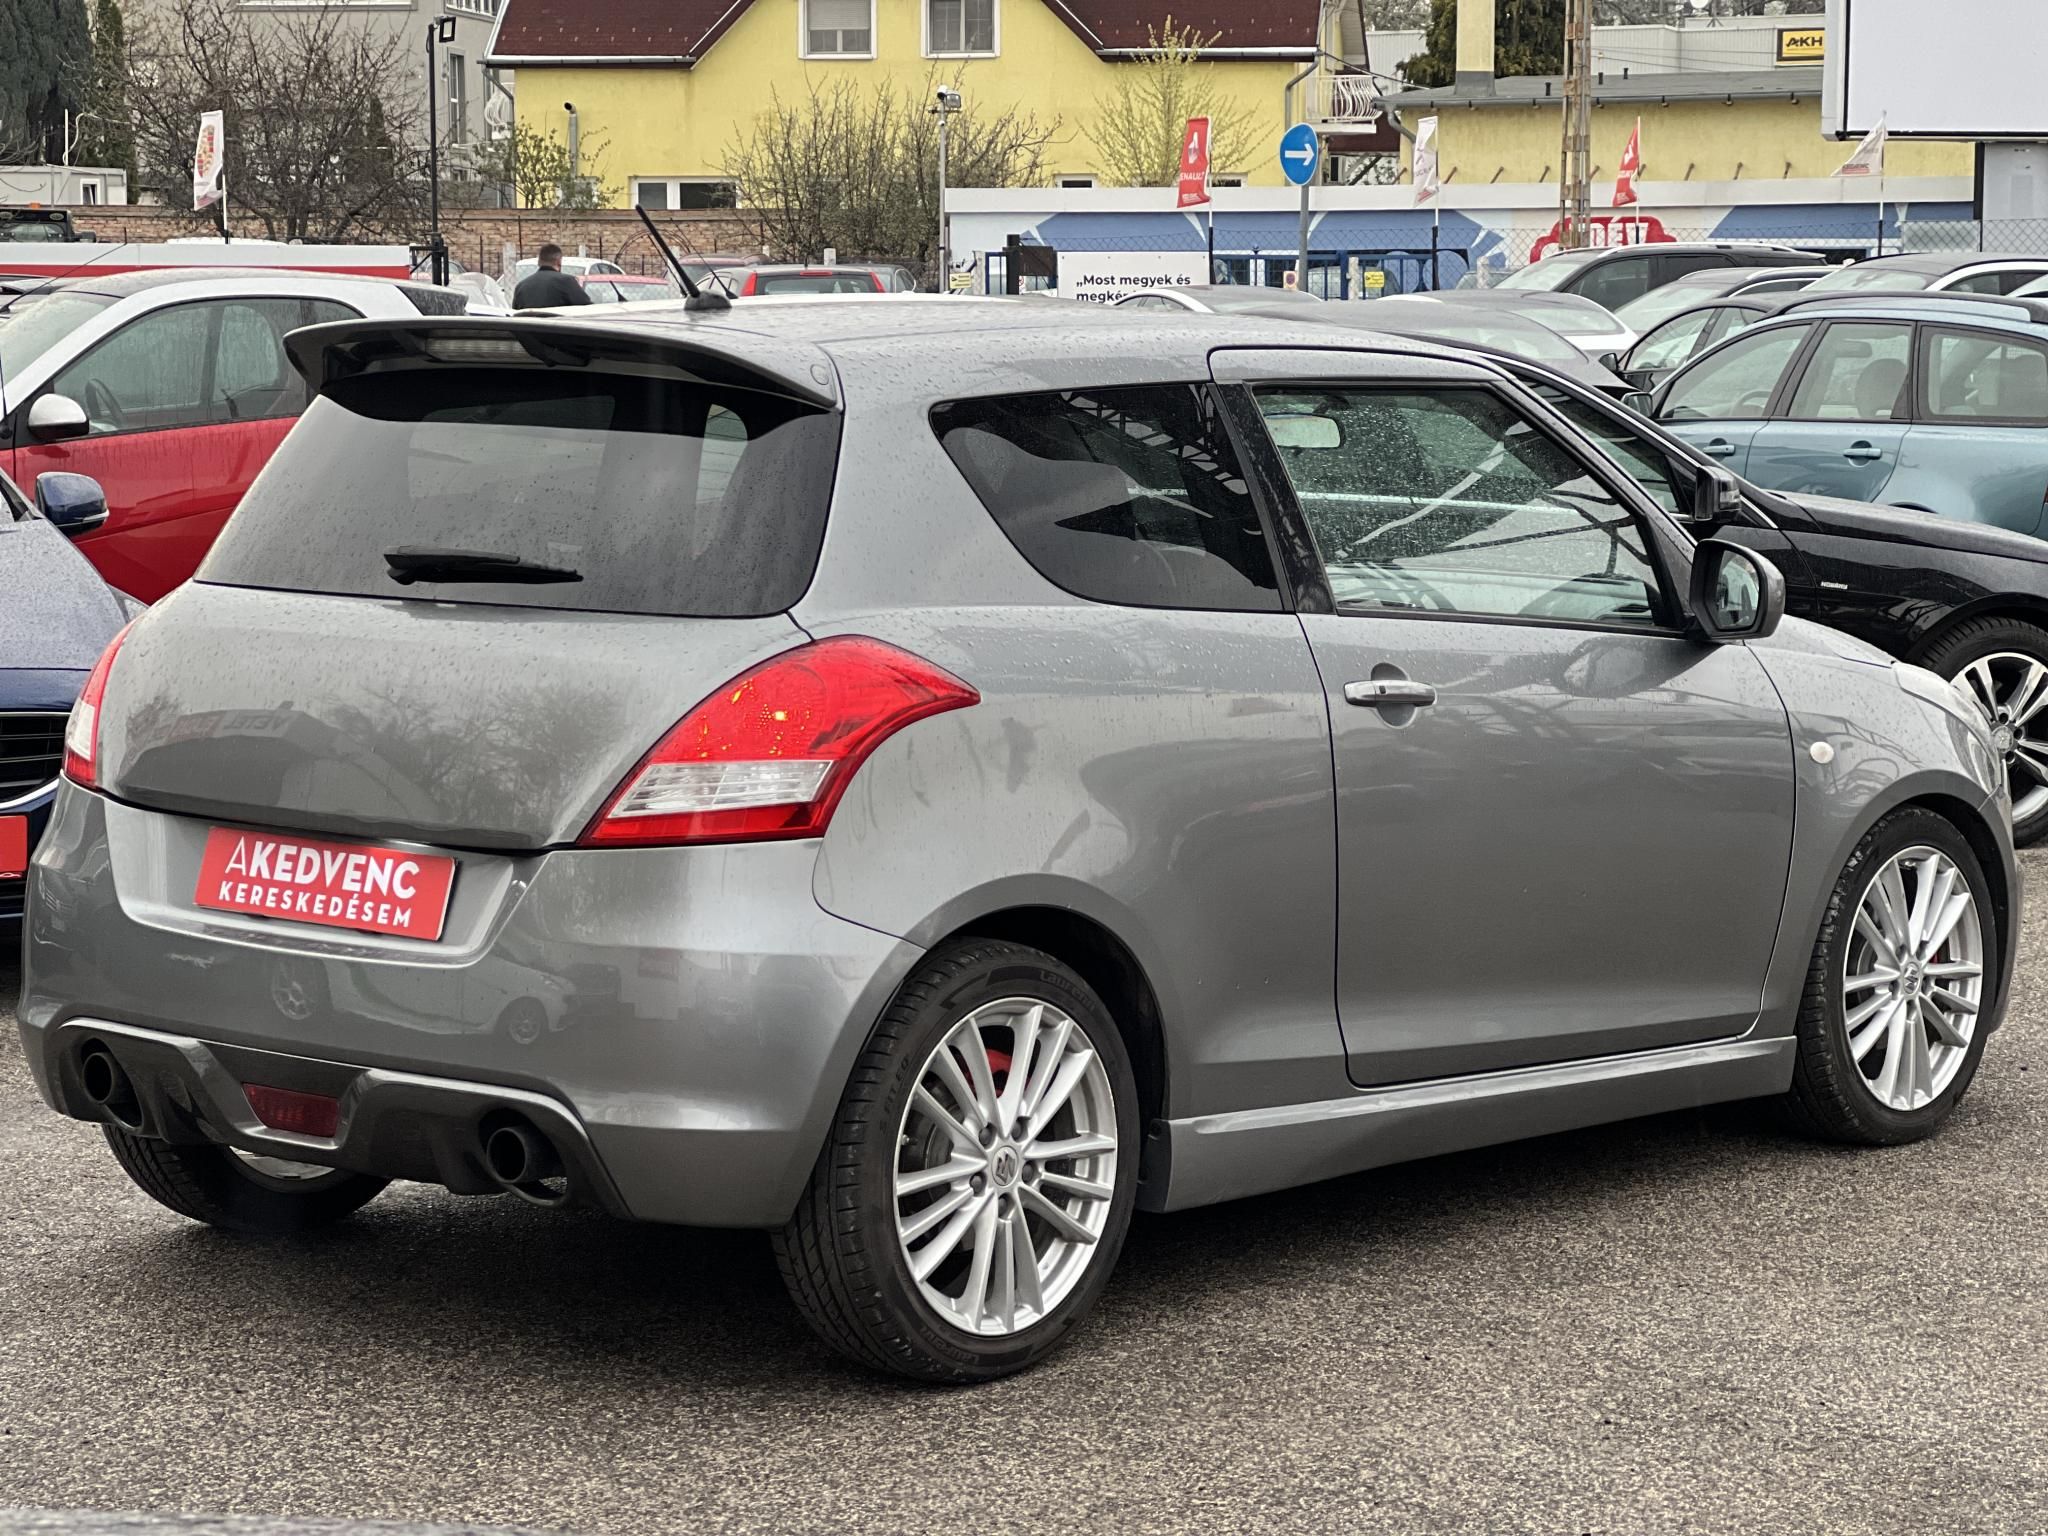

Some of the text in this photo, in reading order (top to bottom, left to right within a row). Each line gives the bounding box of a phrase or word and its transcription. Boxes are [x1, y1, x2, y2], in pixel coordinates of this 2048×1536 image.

[1076, 273, 1191, 287] „Most megyek és
[218, 881, 412, 928] KERESKEDÉSEM
